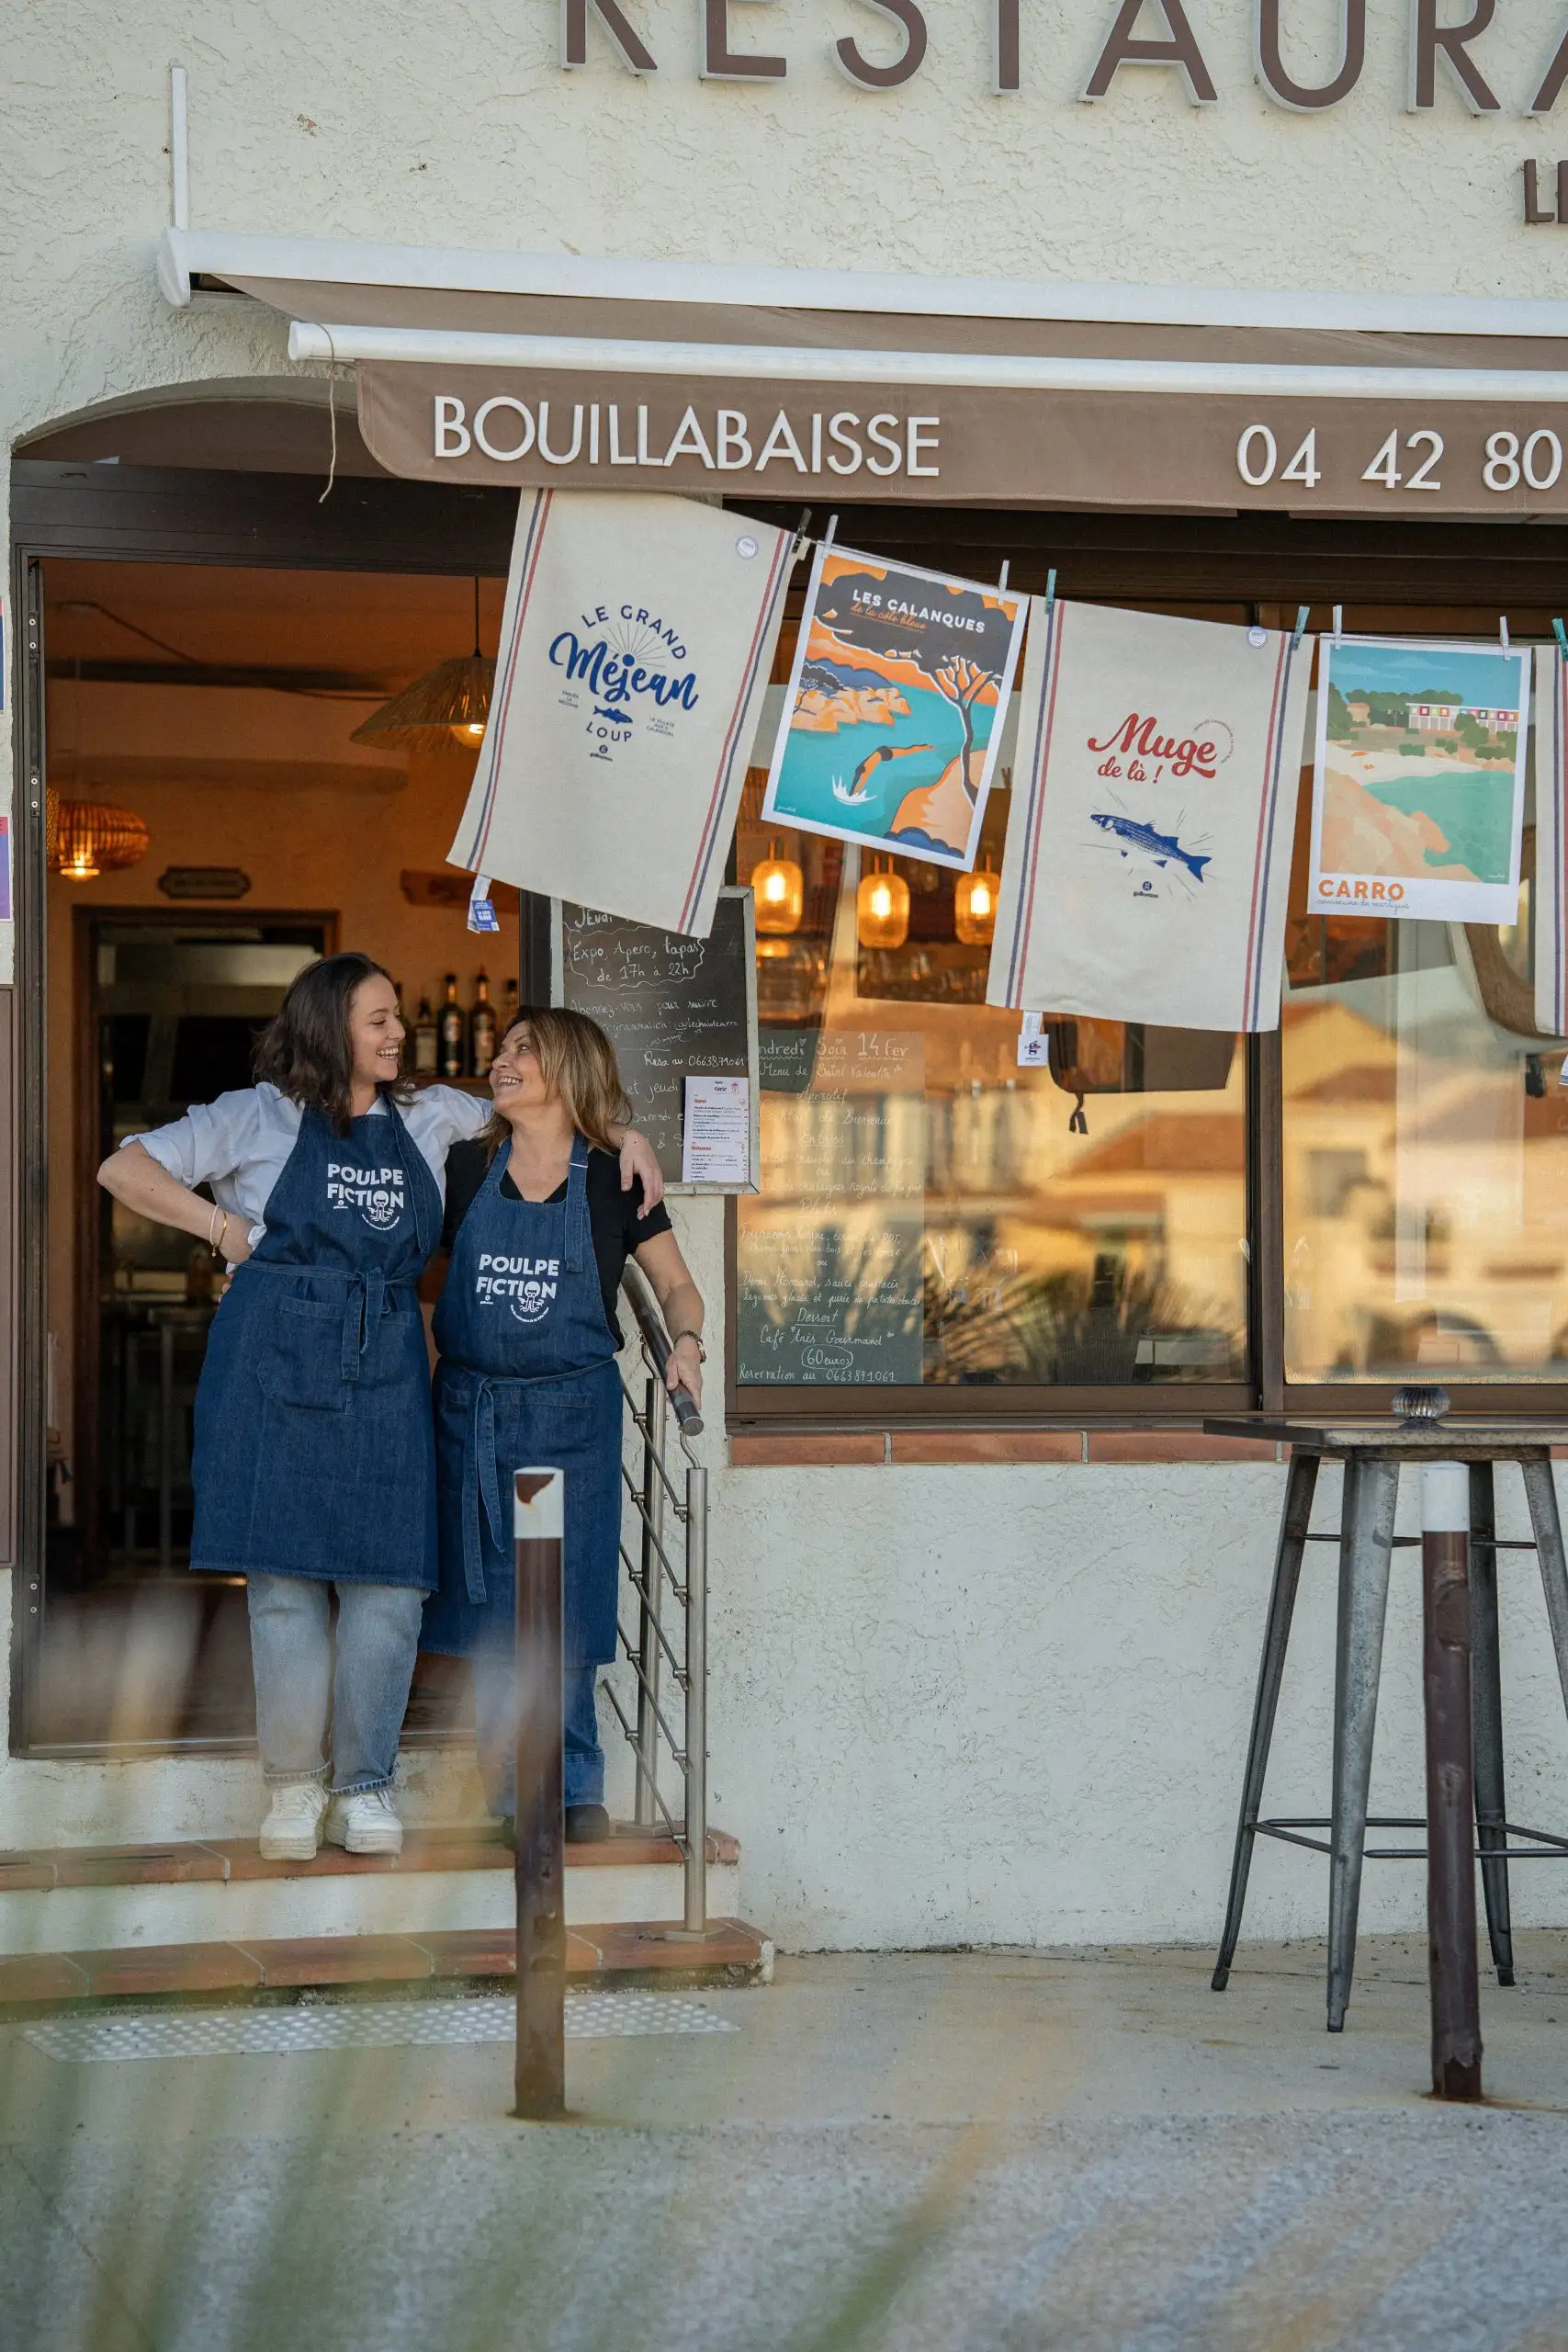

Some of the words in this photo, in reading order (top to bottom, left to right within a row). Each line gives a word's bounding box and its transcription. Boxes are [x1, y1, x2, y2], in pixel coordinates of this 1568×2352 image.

[434, 395, 940, 477] BOUILLABAISSE
[1236, 424, 1321, 488] 04
[1360, 428, 1444, 490] 42
[1483, 429, 1562, 492] 80
[852, 589, 882, 606] LES
[887, 599, 986, 633] CALANQUES
[581, 605, 609, 628] LE
[620, 605, 686, 660] GRAND
[548, 631, 699, 711] Méjean
[586, 721, 632, 741] LOUP
[1088, 713, 1217, 779] Muge
[1098, 755, 1122, 778] de
[1127, 759, 1146, 782] là
[1318, 879, 1404, 901] CARRO
[662, 936, 698, 959] tapas
[597, 968, 611, 982] de
[620, 965, 645, 979] 17h
[669, 964, 689, 976] 22h
[656, 1001, 680, 1017] pour
[687, 999, 717, 1010] suivre
[857, 1032, 879, 1056] 14
[760, 1063, 790, 1076] Menu
[795, 1066, 808, 1076] de
[816, 1063, 844, 1077] Saint
[626, 1080, 640, 1095] et
[645, 1078, 680, 1102] jeudi
[327, 1163, 404, 1185] POULPE
[327, 1183, 404, 1208] FICTION
[479, 1253, 560, 1277] POULPE
[476, 1276, 557, 1299] FICTION
[813, 1294, 823, 1303] et
[796, 1307, 839, 1323] Dessert
[760, 1324, 786, 1351] Café
[826, 1329, 883, 1346] Gourmand
[803, 1370, 816, 1380] au
[826, 1369, 897, 1382] 0663871061
